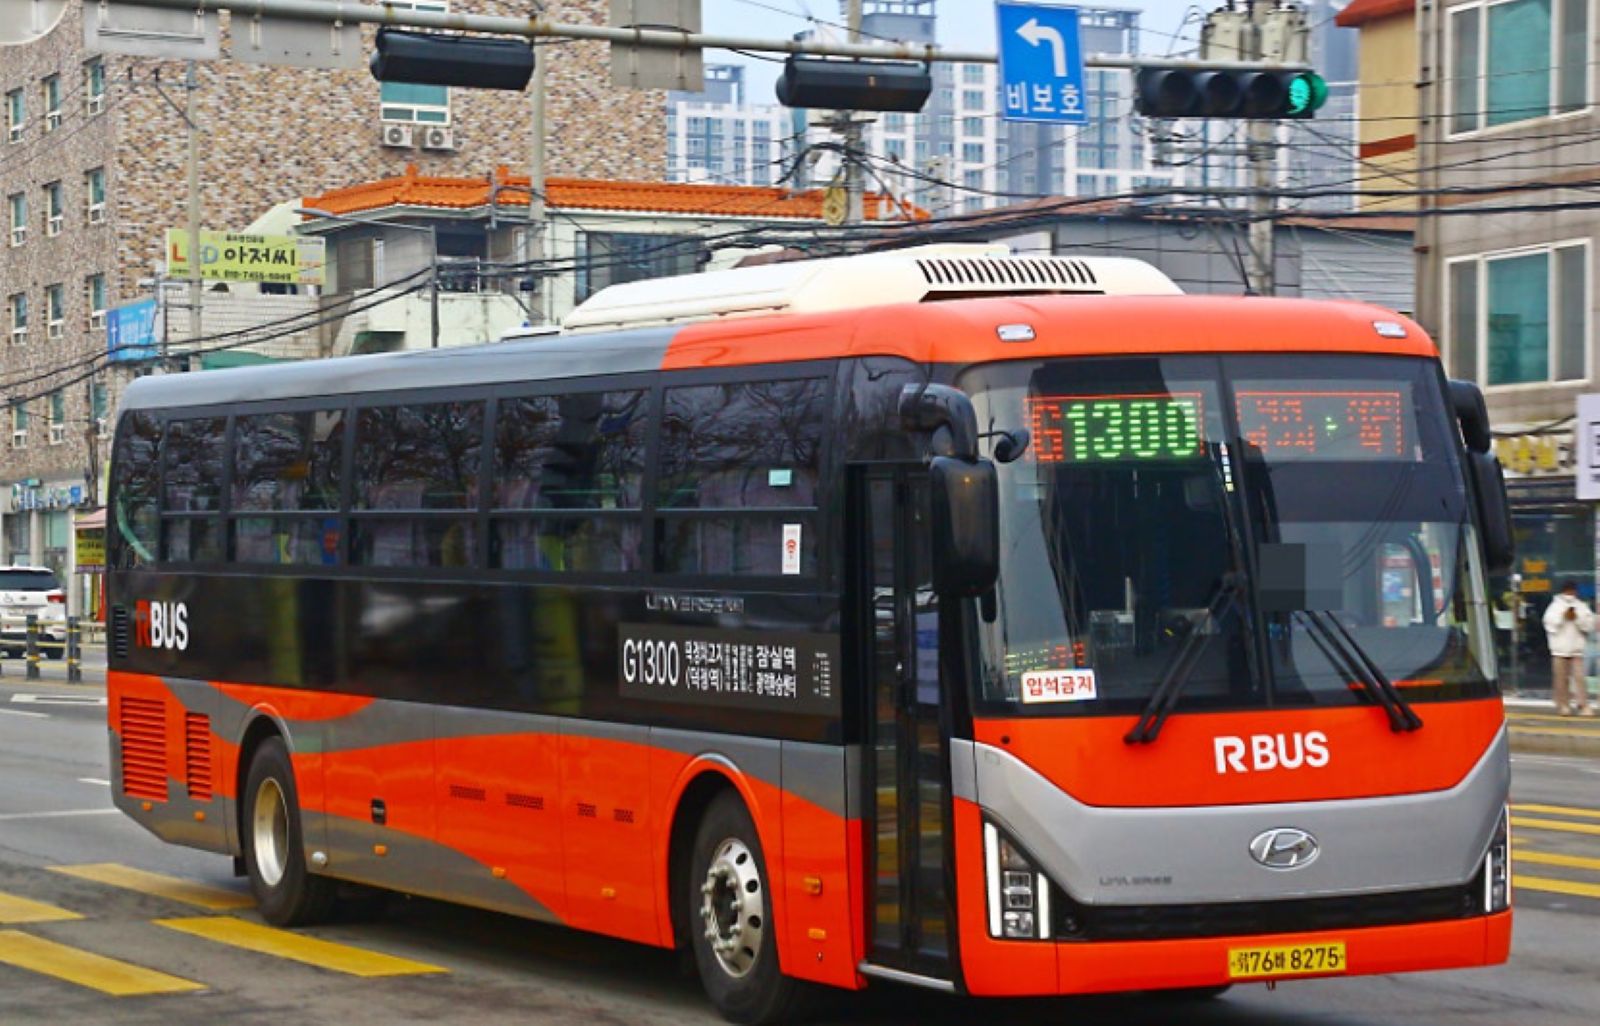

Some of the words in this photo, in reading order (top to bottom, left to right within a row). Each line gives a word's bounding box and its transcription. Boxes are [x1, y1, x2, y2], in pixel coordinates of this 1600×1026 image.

[1006, 81, 1083, 114] 비보호
[172, 243, 219, 265] LD
[225, 245, 295, 266] 아저씨
[1033, 402, 1198, 460] G1300
[623, 638, 680, 686] G1300
[756, 645, 796, 671] 잠실역
[1026, 676, 1092, 696] 입석금지
[1290, 946, 1339, 970] 8275
